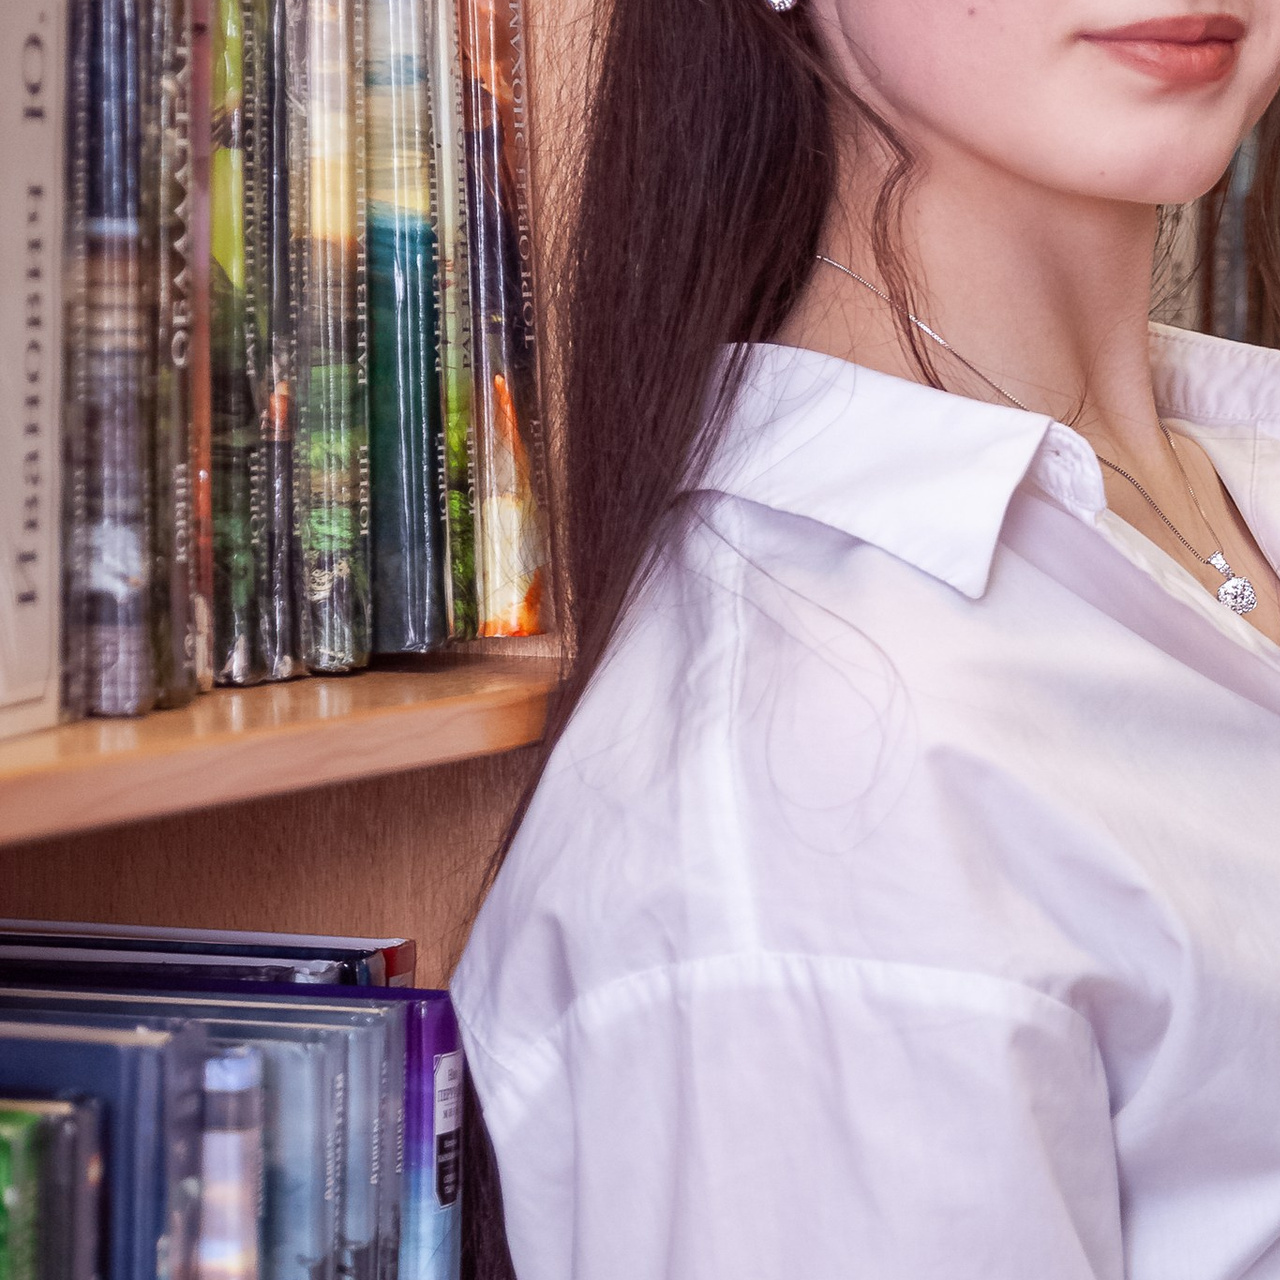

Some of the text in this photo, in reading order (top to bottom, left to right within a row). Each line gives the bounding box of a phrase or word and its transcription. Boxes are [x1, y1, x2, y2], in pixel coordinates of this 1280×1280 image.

[355, 135, 366, 271] НАШЕГО
[13, 7, 48, 608] Иванович Ю.
[356, 282, 367, 319] ИЗ
[356, 327, 367, 384] РАБ
[461, 315, 471, 368] РАБ
[357, 443, 369, 536] ЮРИЙ
